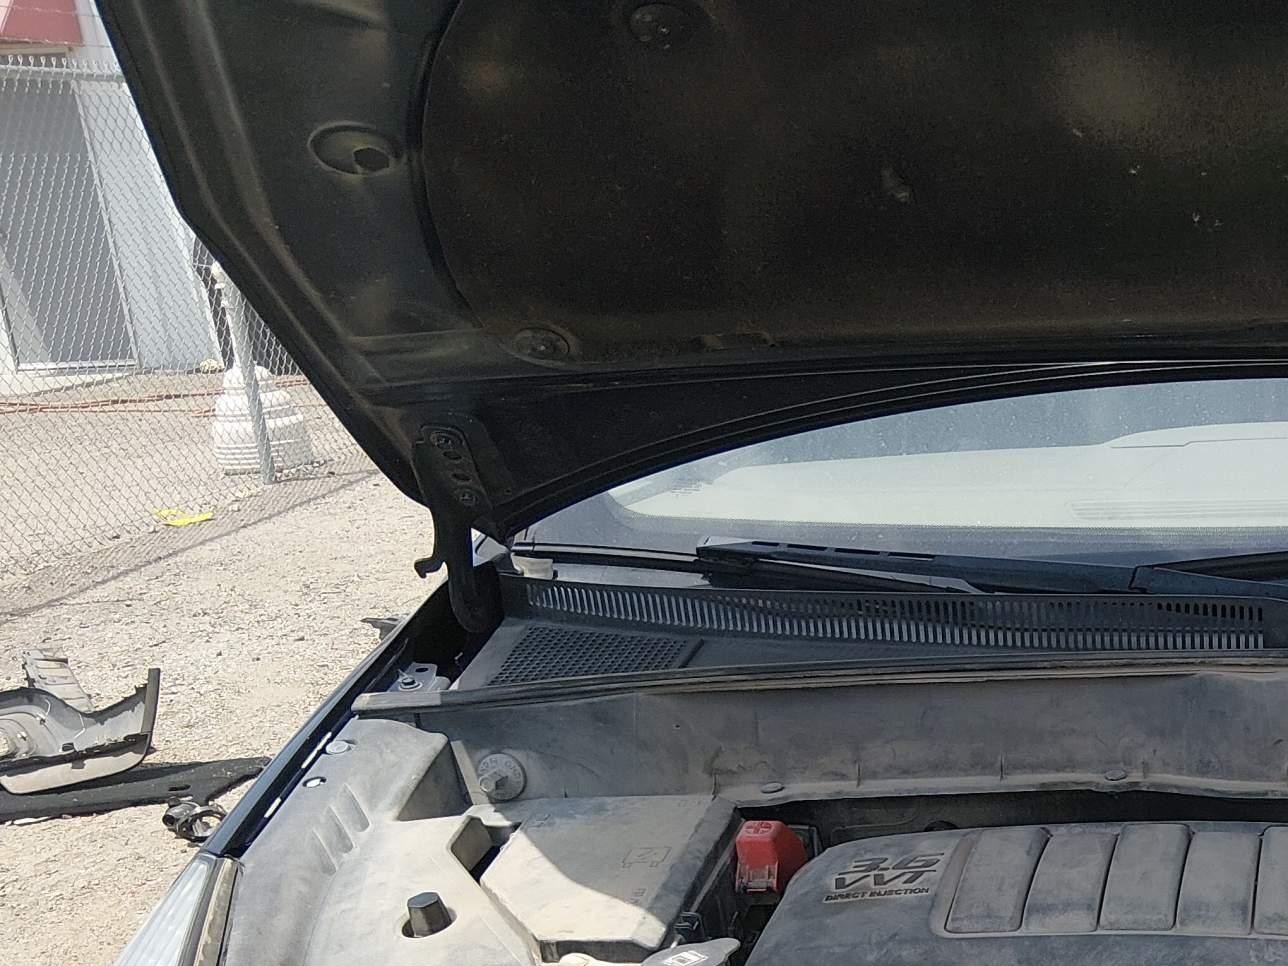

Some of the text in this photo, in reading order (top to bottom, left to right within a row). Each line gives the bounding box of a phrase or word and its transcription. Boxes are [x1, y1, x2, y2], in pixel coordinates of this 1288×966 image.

[838, 852, 944, 876] 3.6
[835, 869, 937, 890] VVT
[825, 887, 929, 902] DIRECT INJECTION
